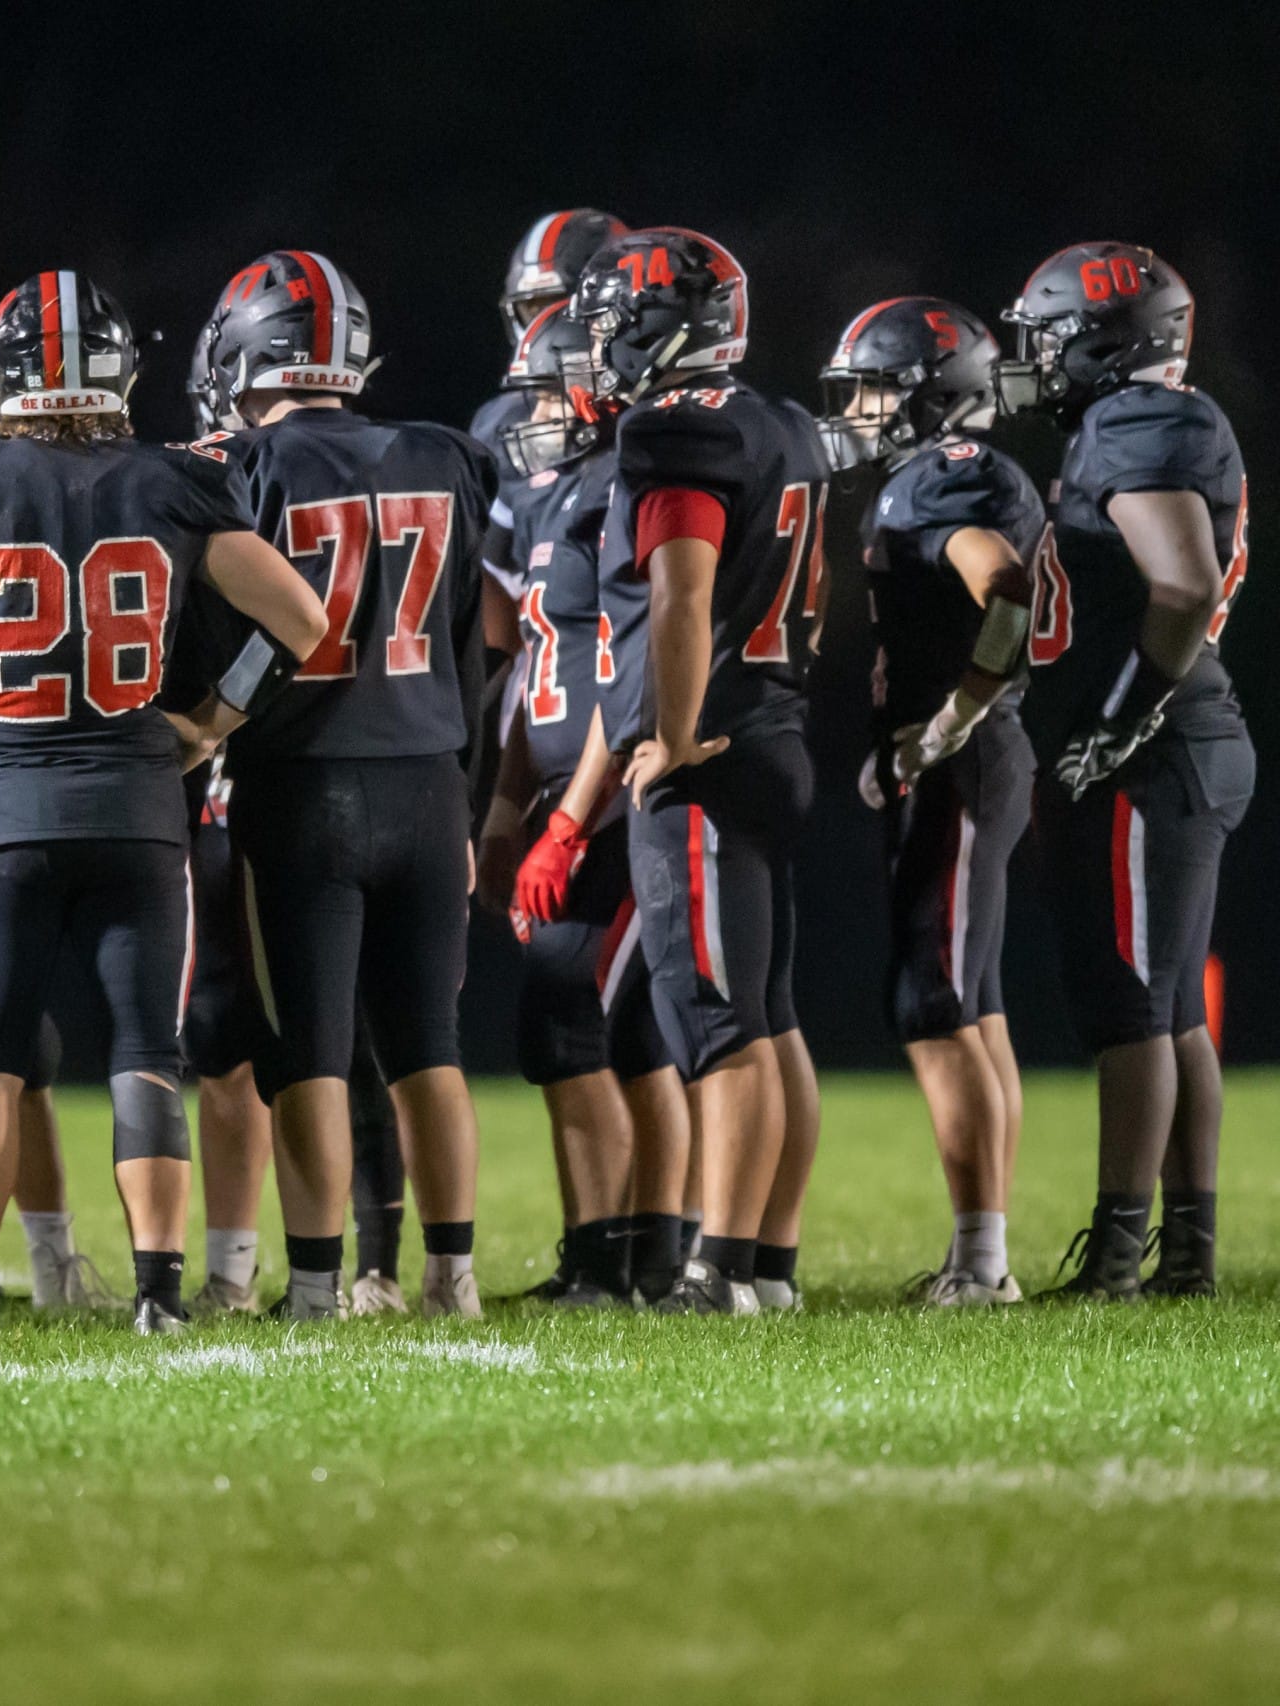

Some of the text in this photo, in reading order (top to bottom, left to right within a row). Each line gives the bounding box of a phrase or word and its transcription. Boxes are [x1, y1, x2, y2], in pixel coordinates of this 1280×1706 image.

[224, 264, 272, 308] 77
[617, 247, 675, 296] 74
[1080, 258, 1140, 301] 60
[924, 311, 959, 349] 5
[282, 372, 301, 384] BE
[293, 352, 310, 364] 77
[21, 398, 38, 410] BE
[286, 491, 455, 681] 77
